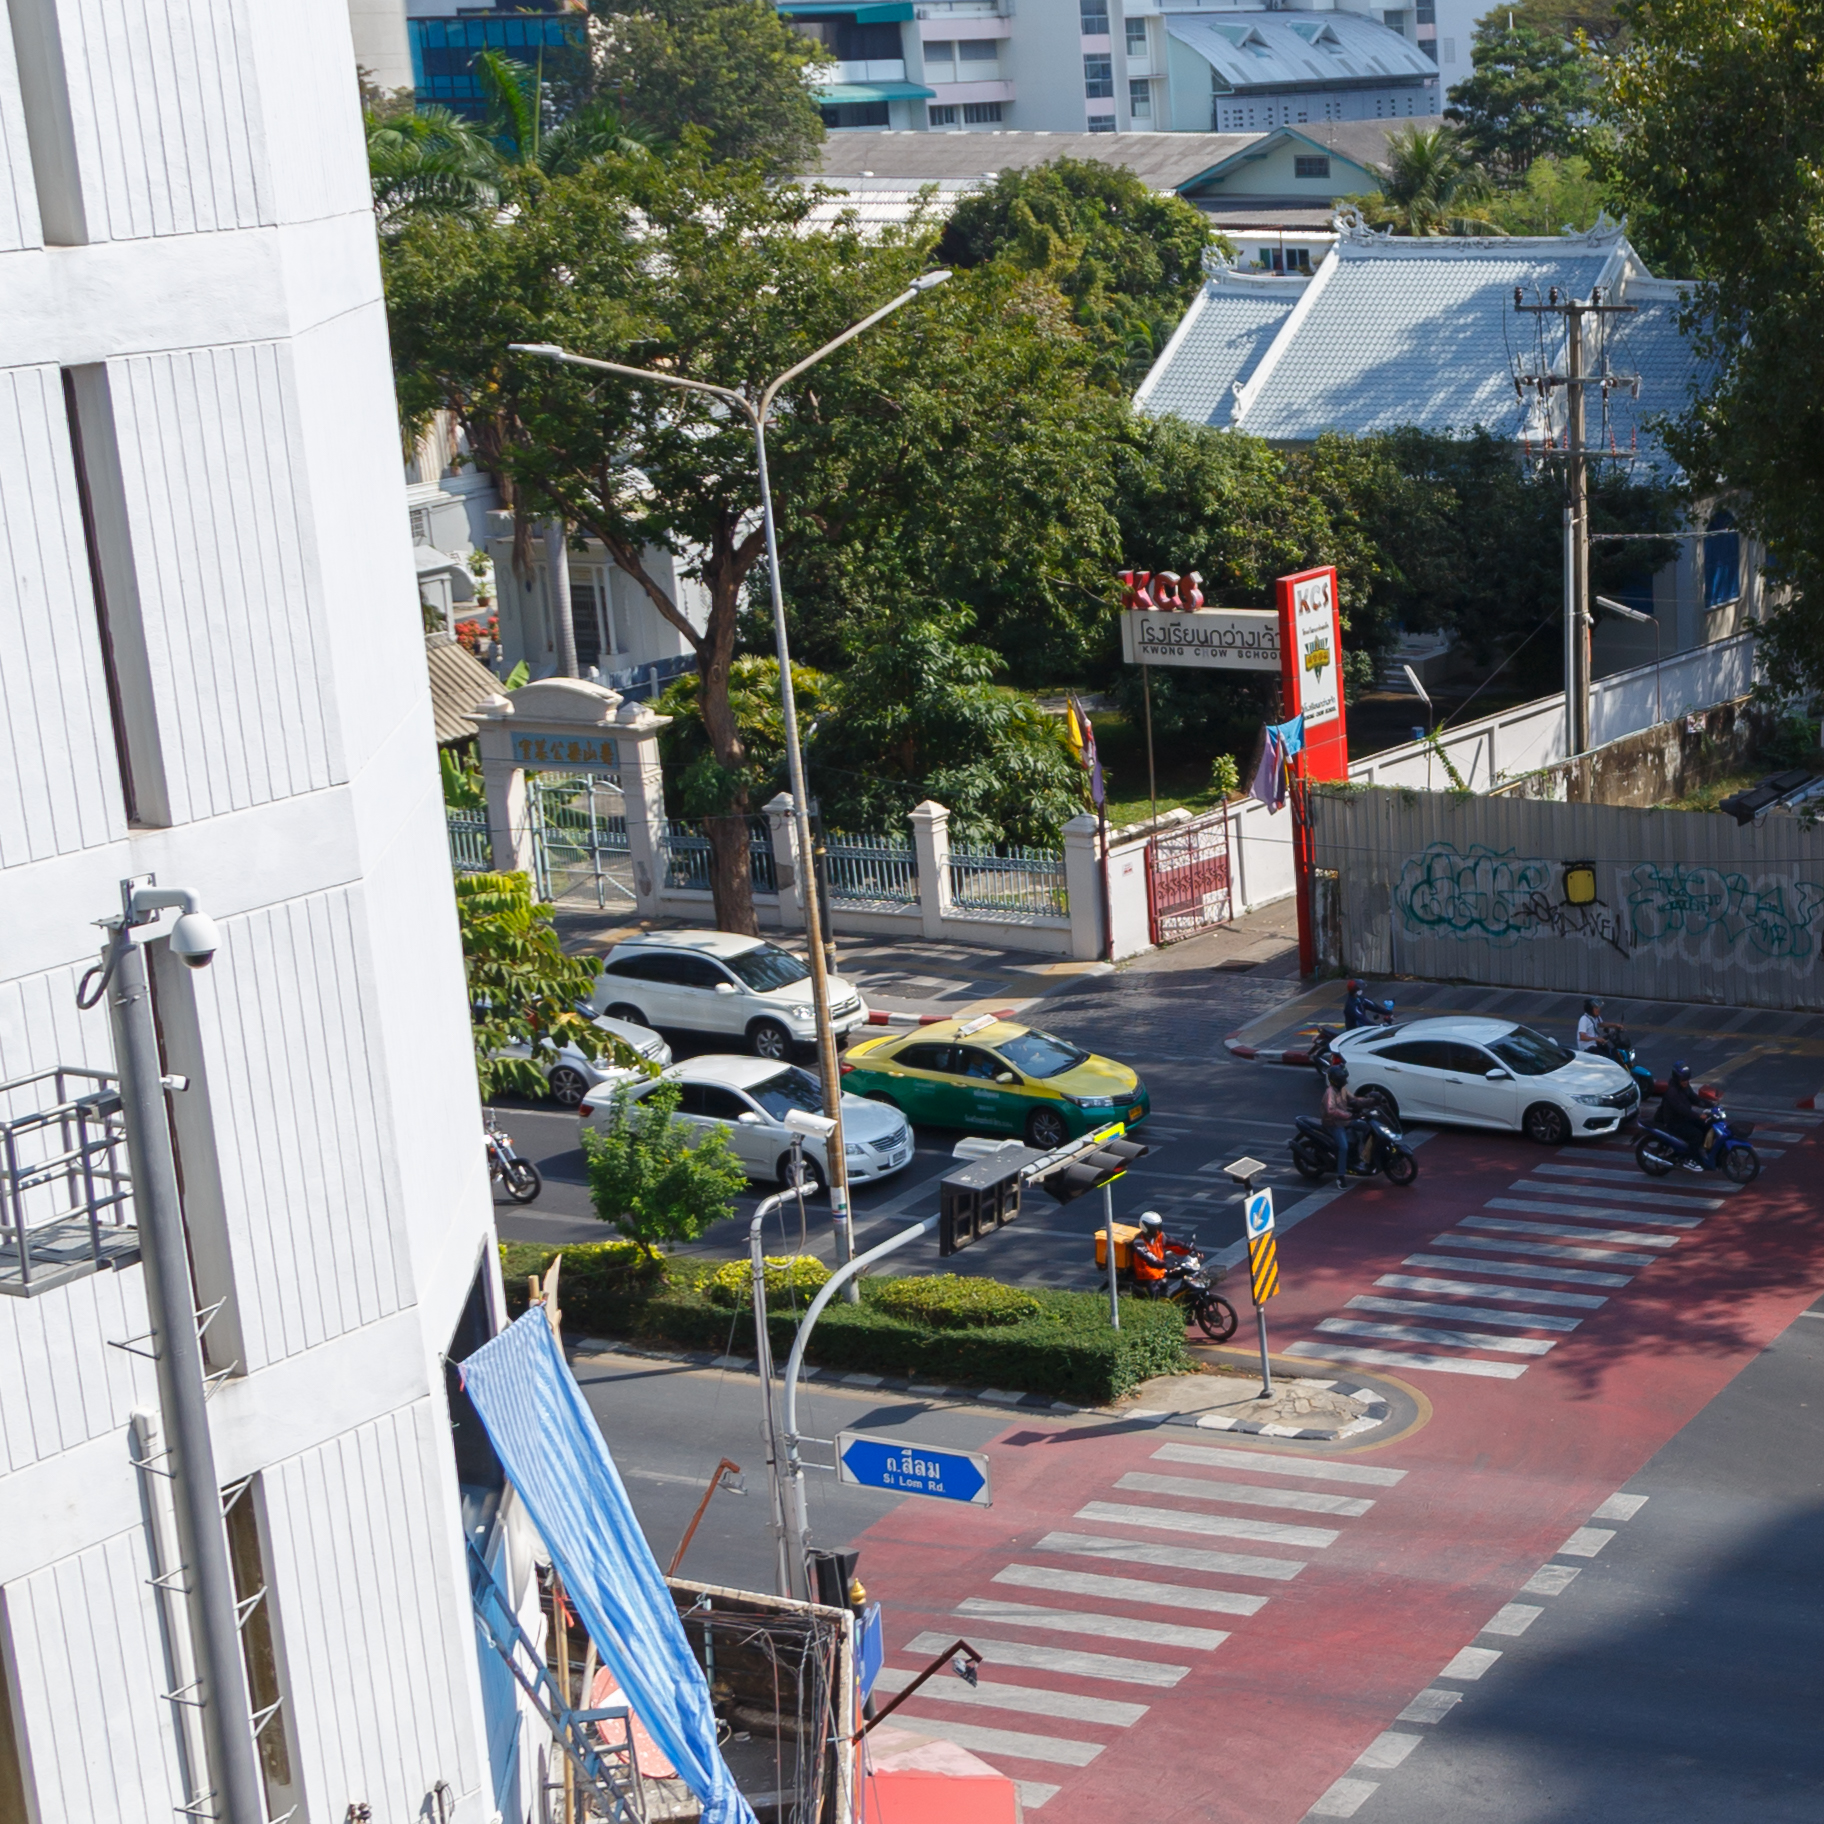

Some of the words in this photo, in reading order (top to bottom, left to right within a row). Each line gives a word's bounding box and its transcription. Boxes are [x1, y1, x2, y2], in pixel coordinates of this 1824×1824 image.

[1117, 570, 1205, 612] KCS
[1297, 582, 1330, 616] KCS
[1142, 645, 1185, 656] KWONG
[1194, 647, 1228, 658] CHOW
[1237, 650, 1281, 661] SCHOO
[886, 1449, 940, 1479] ถ.สีลม
[883, 1473, 895, 1484] Si
[899, 1476, 923, 1489] Lom
[928, 1481, 946, 1493] Rd.
